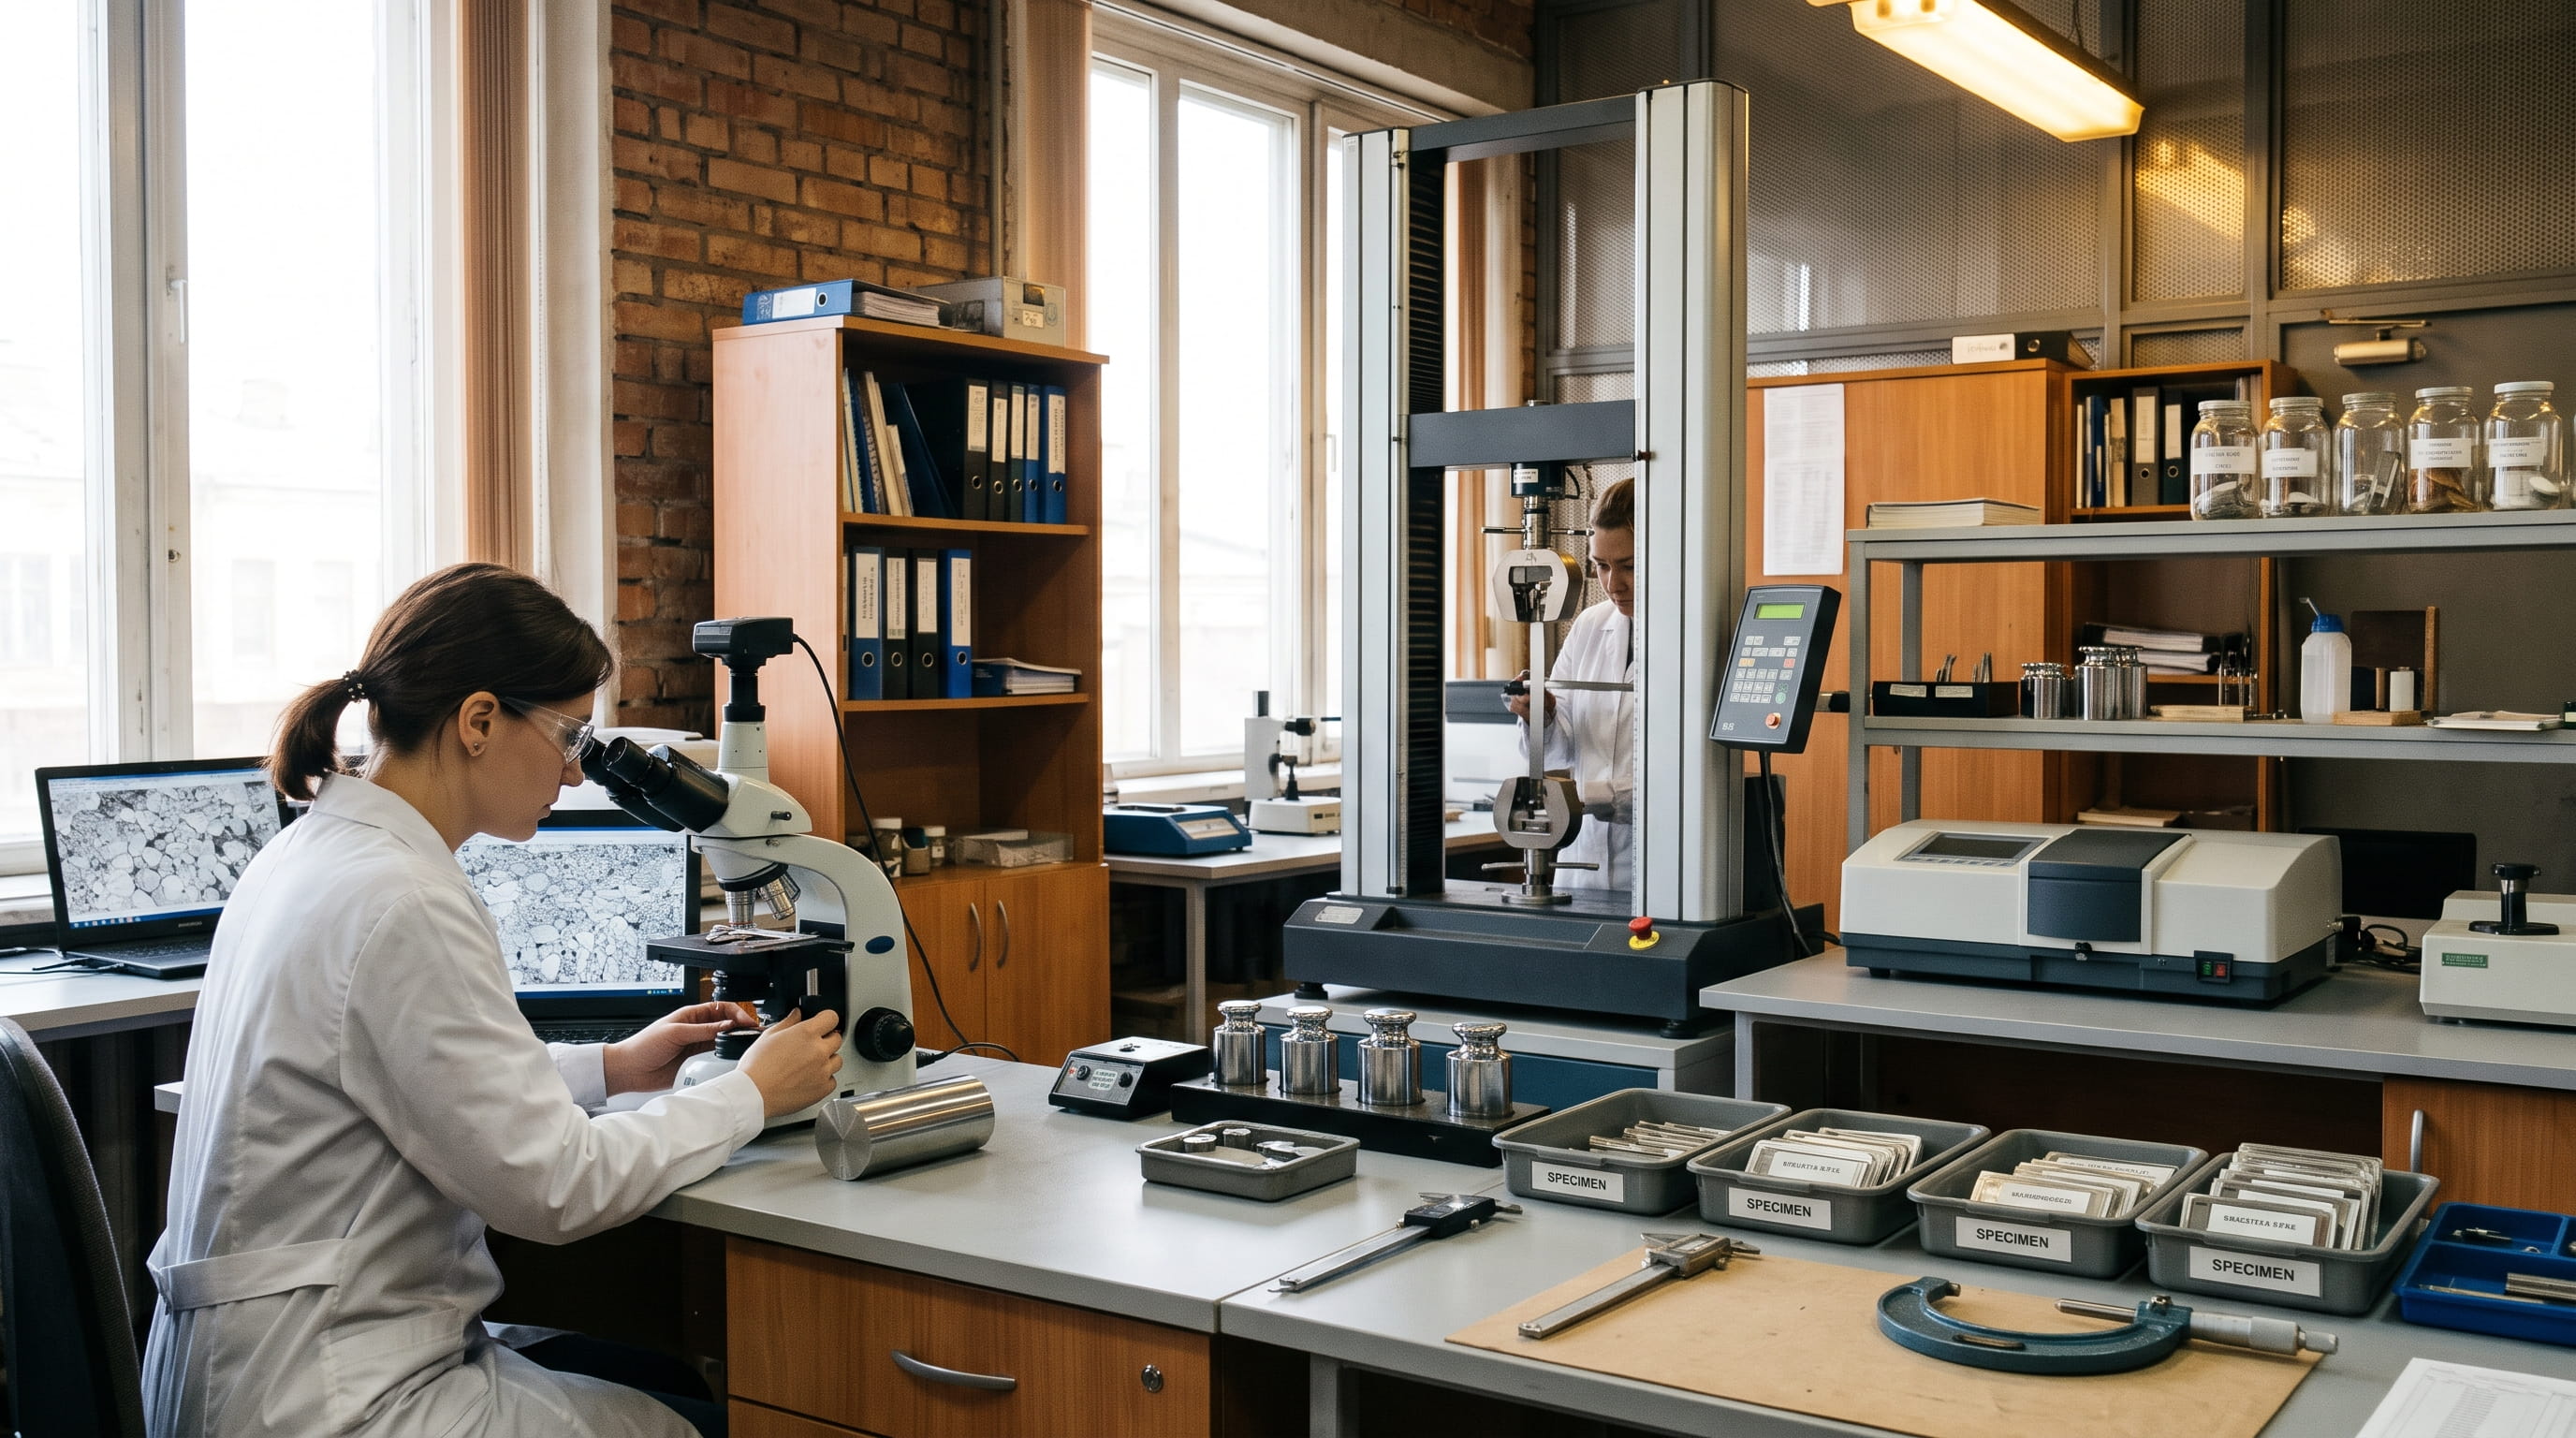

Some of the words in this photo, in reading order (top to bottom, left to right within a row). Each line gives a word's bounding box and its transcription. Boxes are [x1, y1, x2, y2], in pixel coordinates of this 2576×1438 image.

[1547, 1172, 1606, 1190] SPECIMEN
[1747, 1198, 1811, 1217] SPECIMEN
[1976, 1228, 2049, 1248] SPECIMEN
[2212, 1259, 2295, 1281] SPECIMEN
